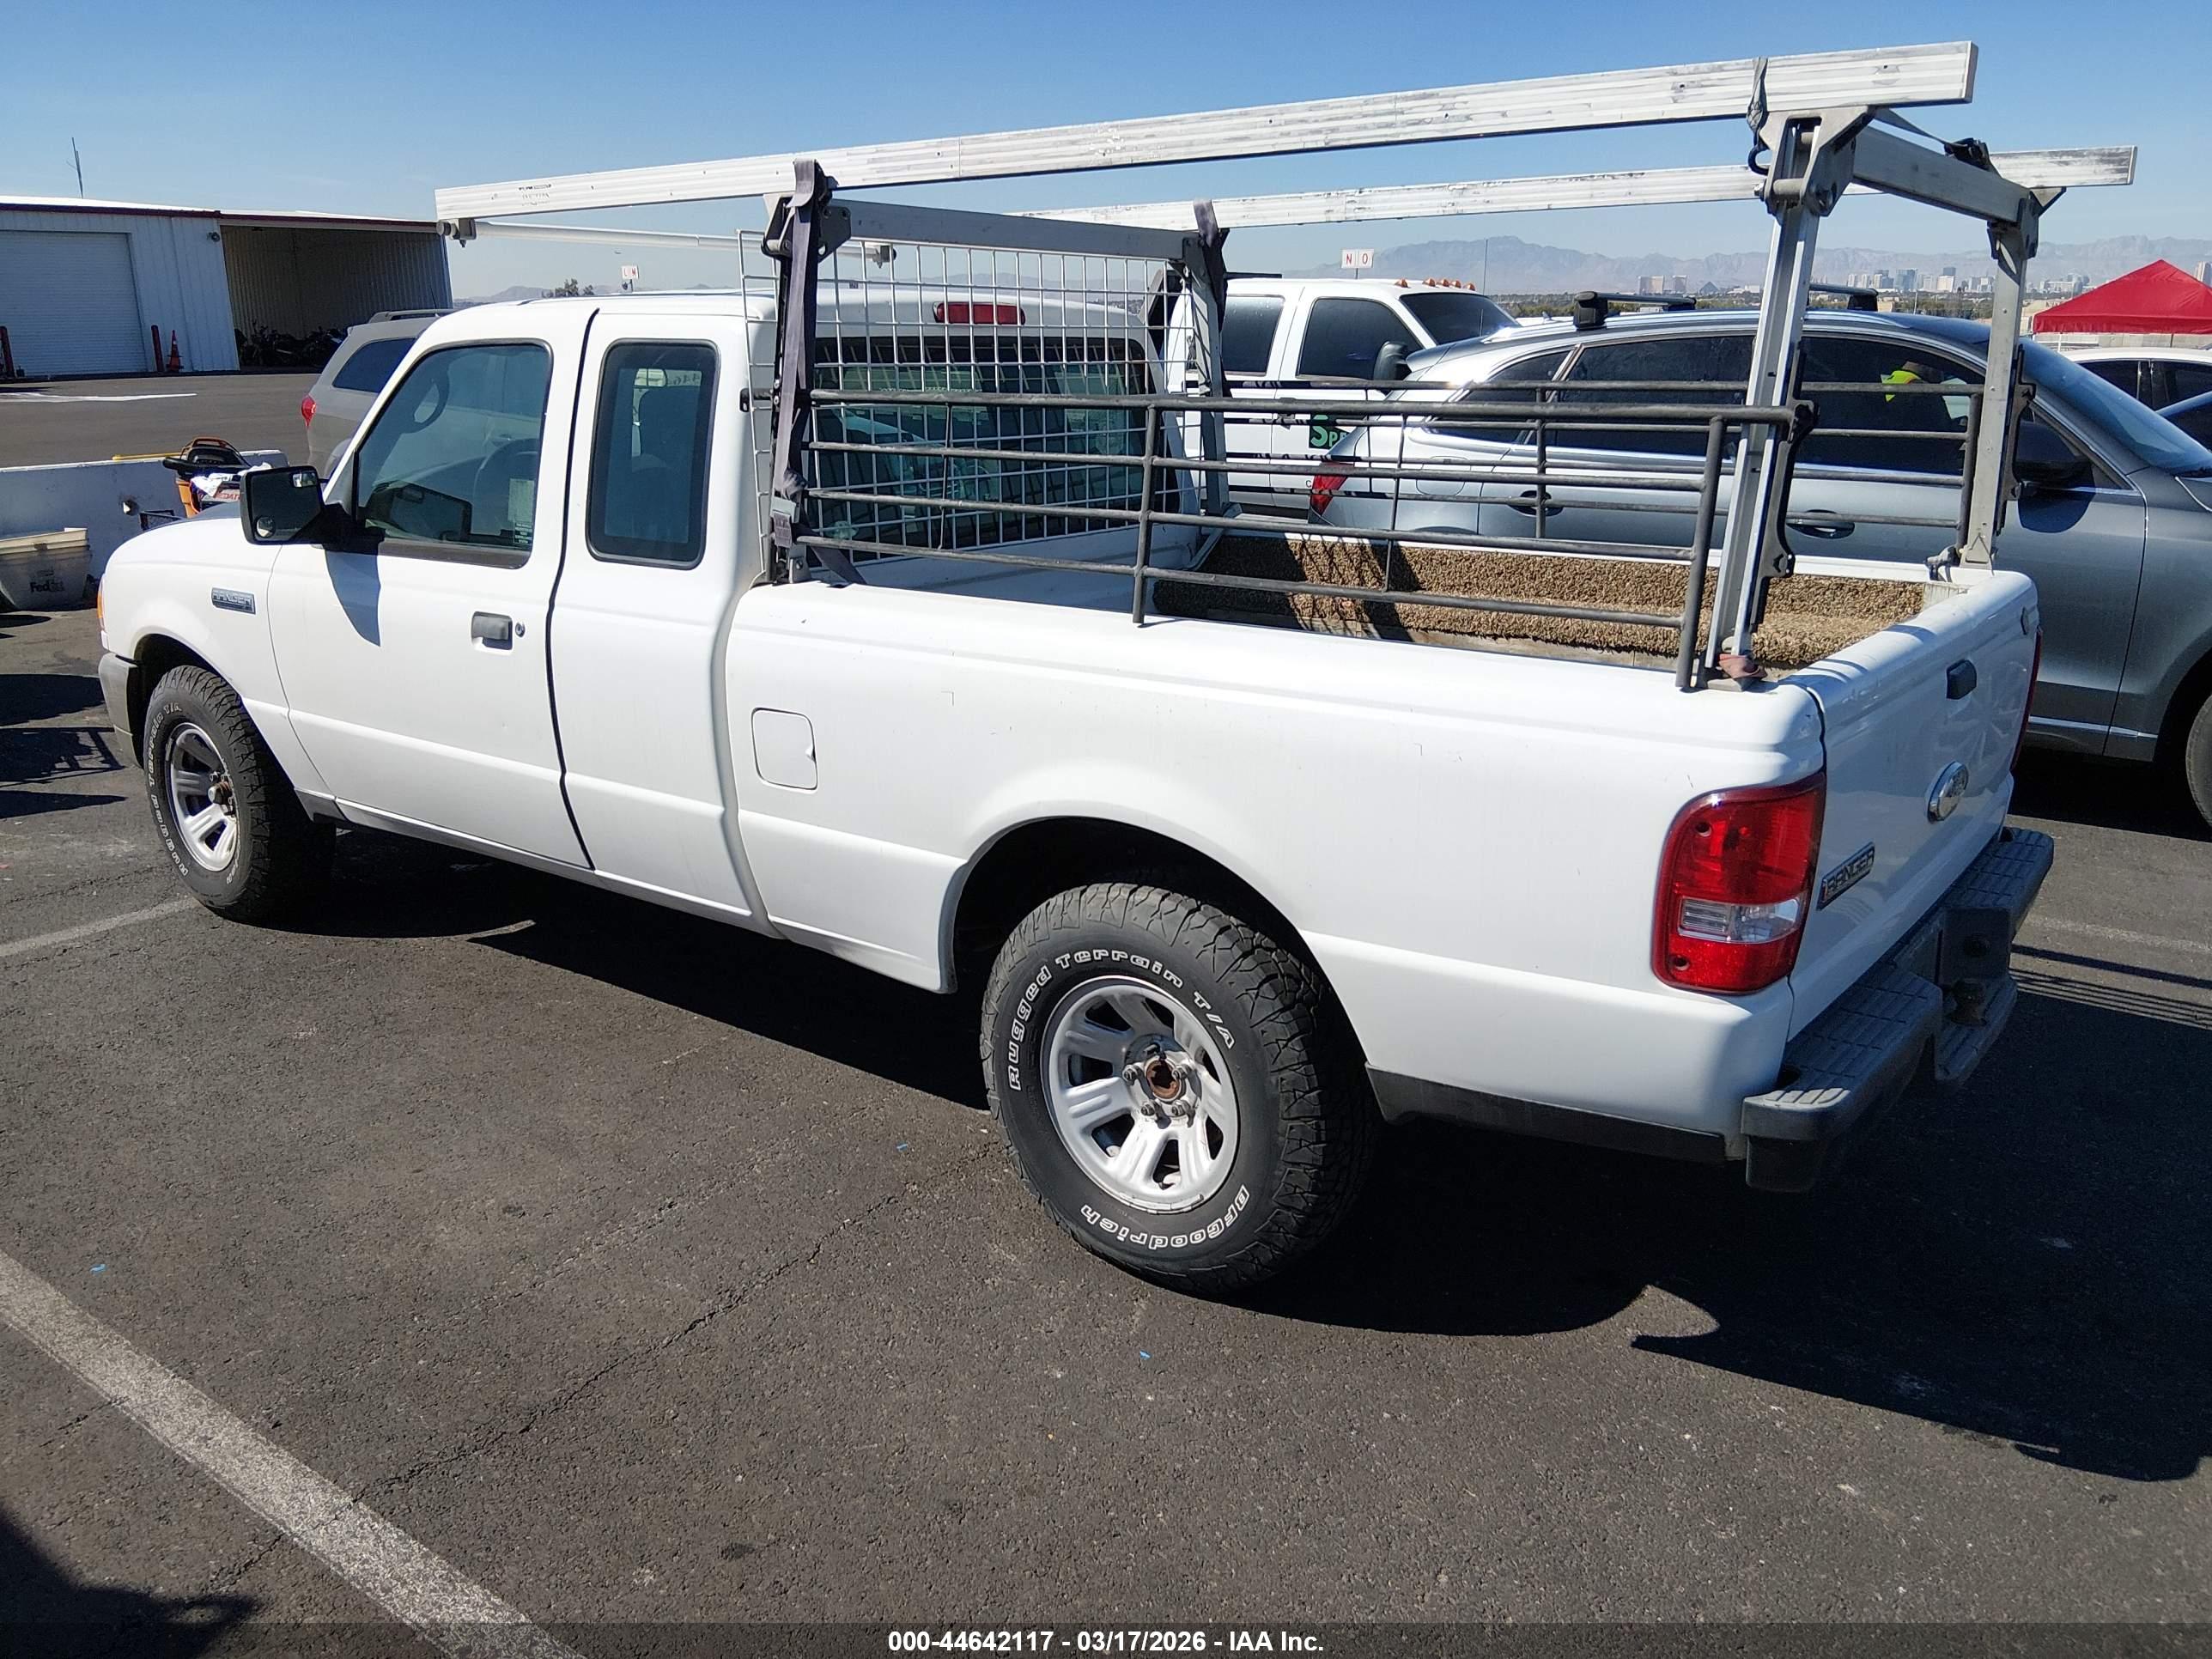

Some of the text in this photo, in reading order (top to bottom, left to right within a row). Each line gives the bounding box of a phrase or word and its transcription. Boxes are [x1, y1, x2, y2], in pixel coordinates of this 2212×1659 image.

[211, 589, 252, 605] RANGER
[1825, 848, 1874, 895] RANGER
[1008, 948, 1236, 1091] Rugged Terrain T/A
[1080, 1183, 1251, 1251] BFGoodrich
